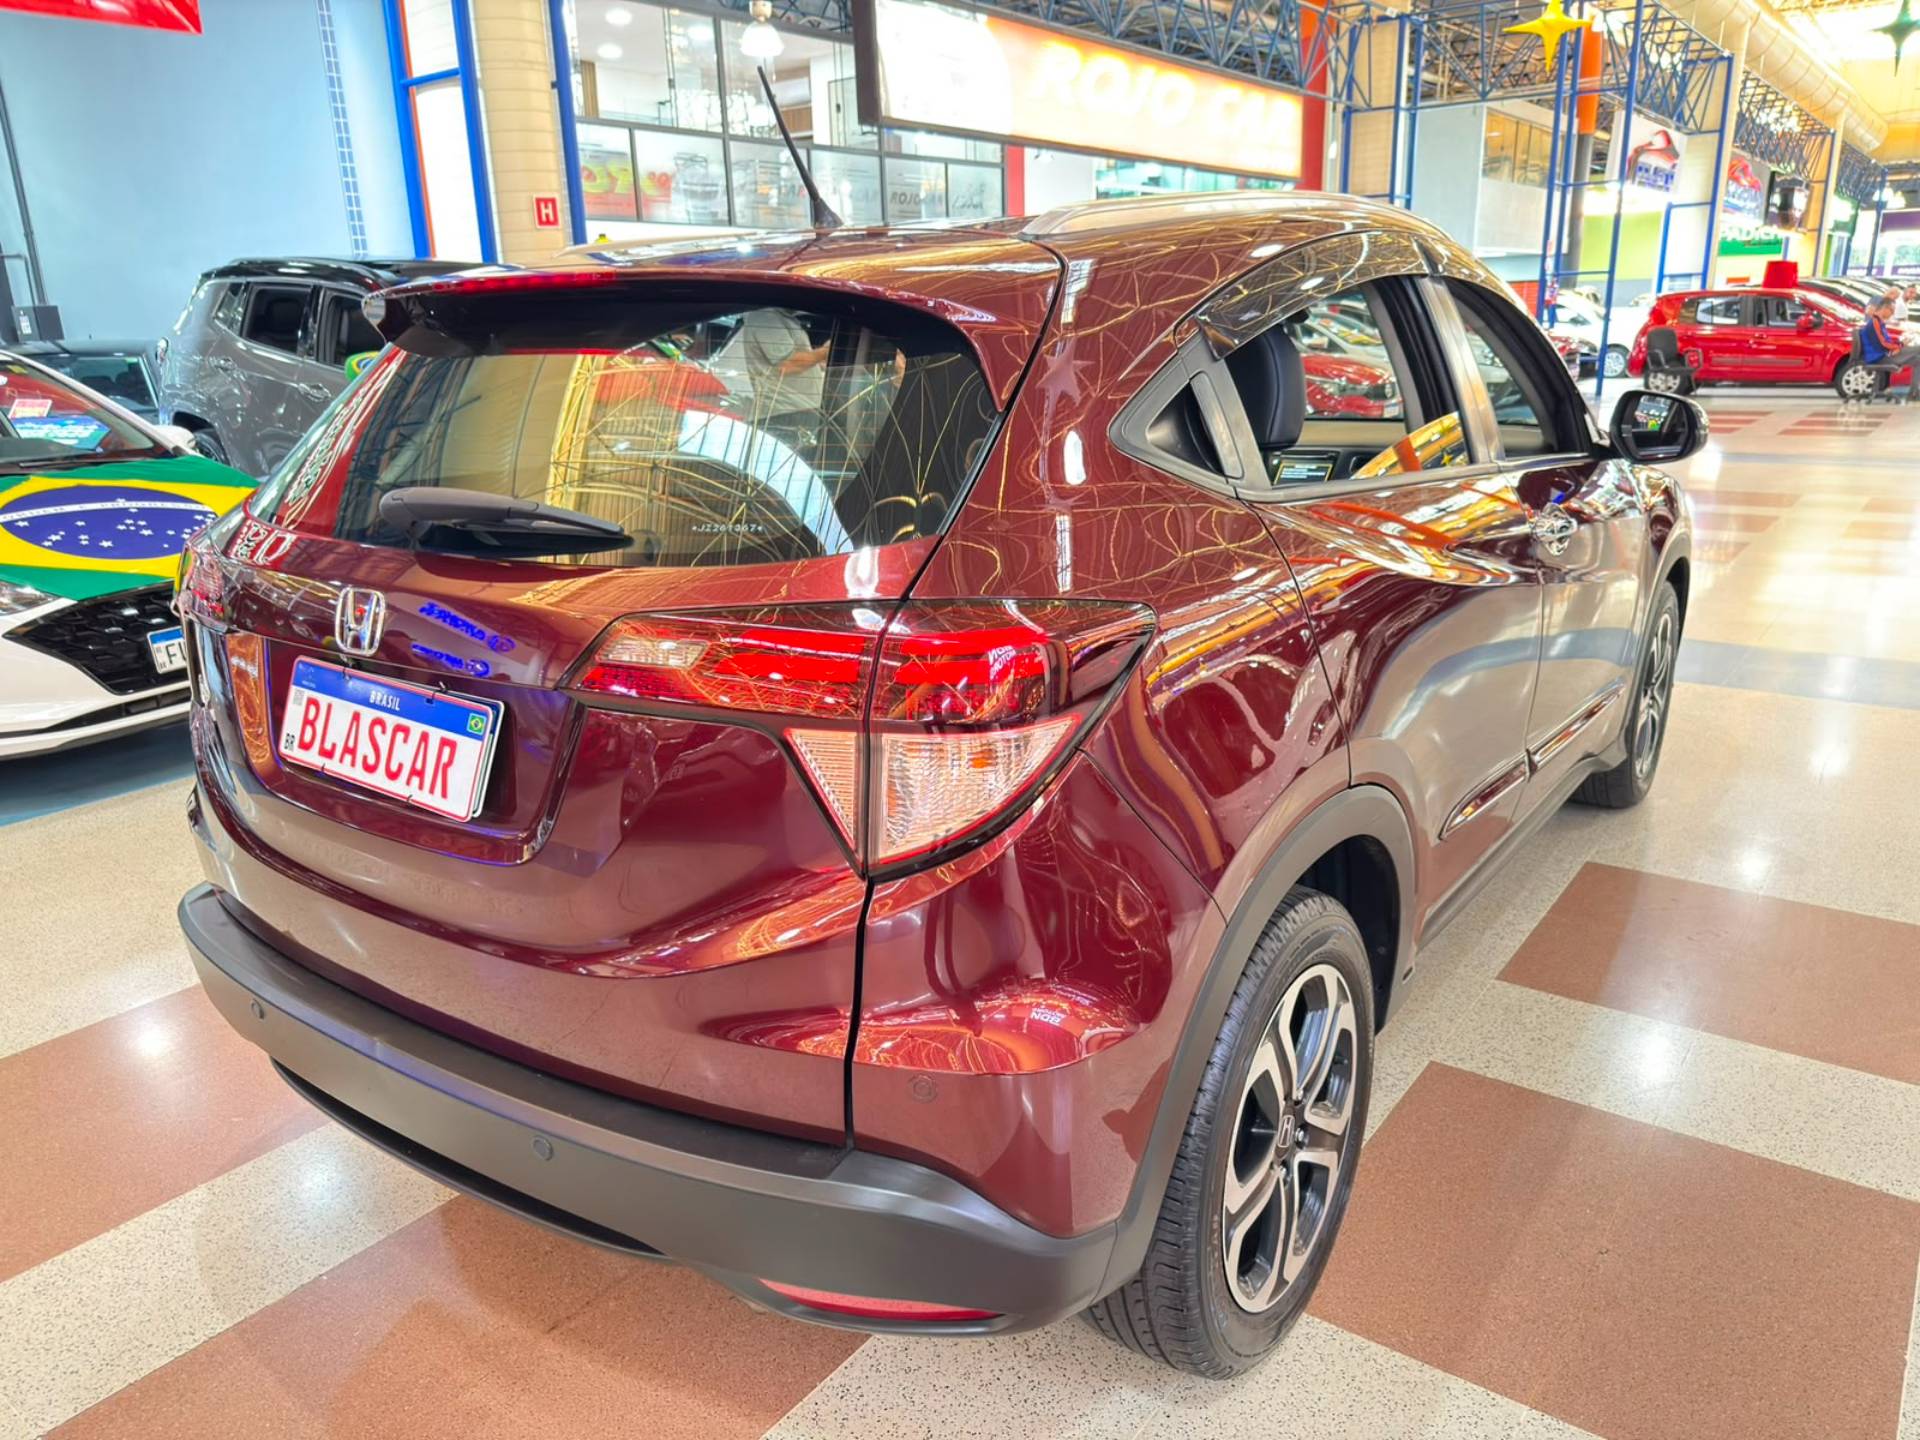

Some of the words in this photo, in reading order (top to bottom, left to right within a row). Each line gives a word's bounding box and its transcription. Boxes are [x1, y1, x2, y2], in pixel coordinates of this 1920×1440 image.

[1033, 41, 1195, 127] ROJO
[541, 201, 554, 222] H
[369, 690, 400, 711] BRASIL
[298, 696, 458, 799] BLASCAR
